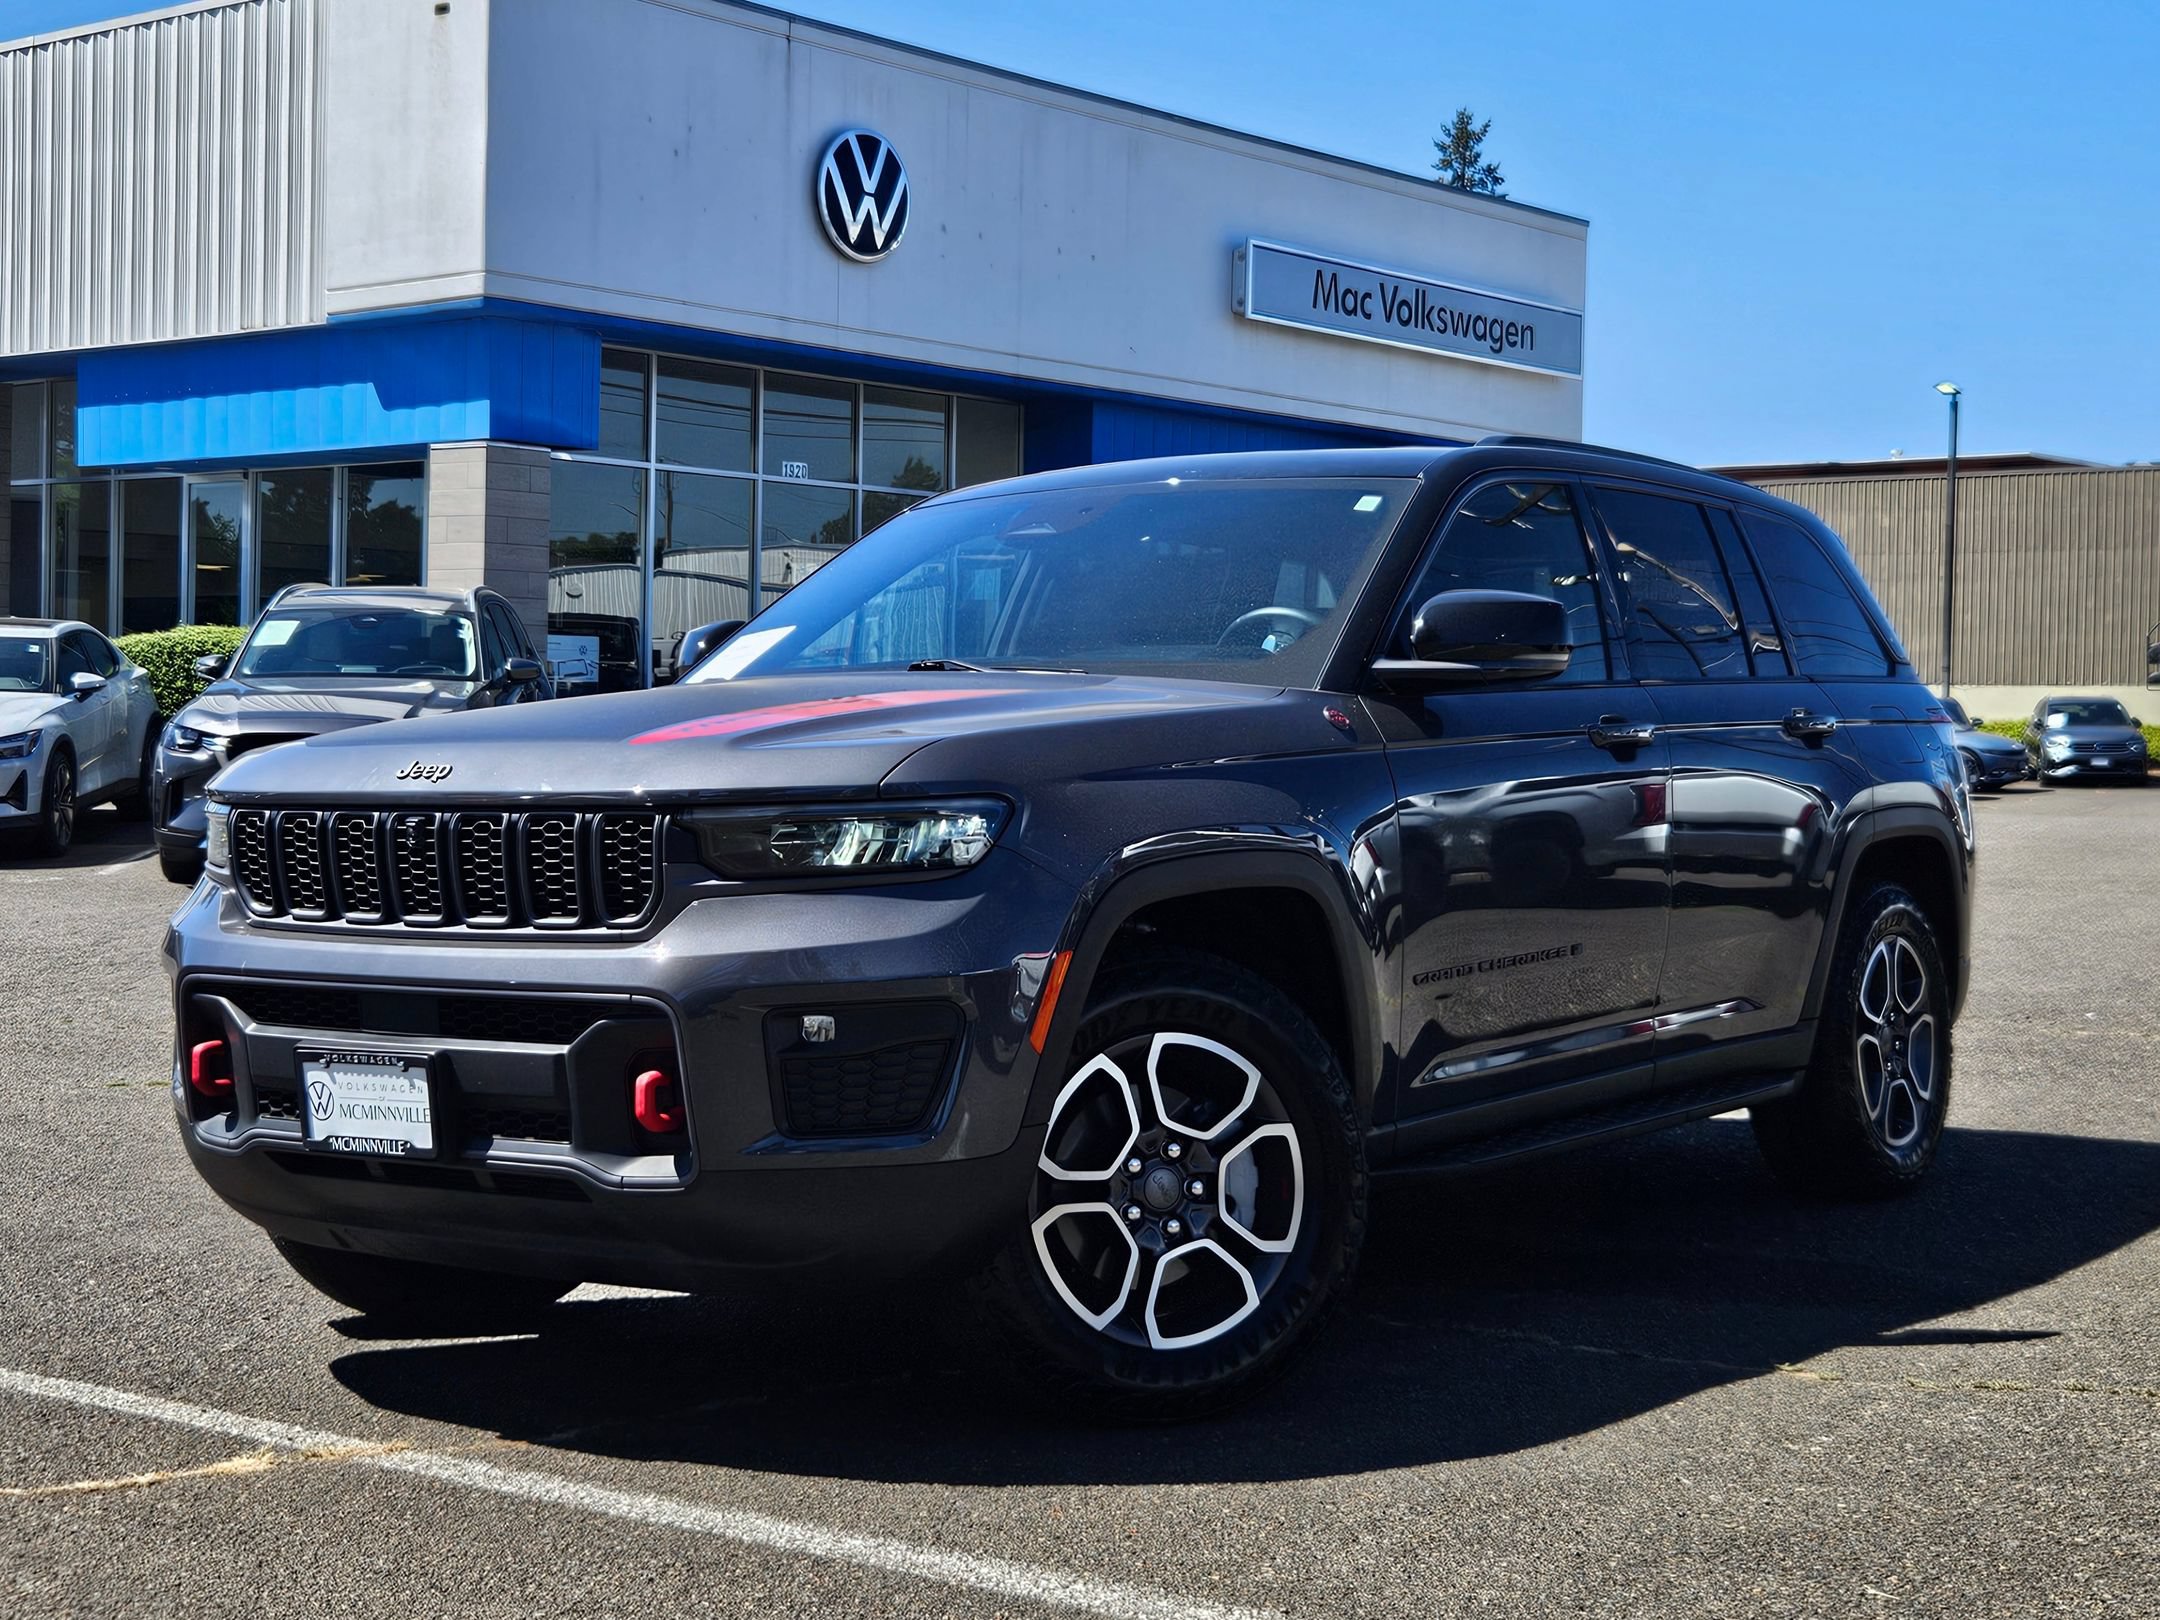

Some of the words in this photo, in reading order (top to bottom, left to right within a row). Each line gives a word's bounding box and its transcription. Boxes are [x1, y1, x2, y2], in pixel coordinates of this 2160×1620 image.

[1312, 269, 1372, 320] Mac
[1379, 282, 1535, 354] Volkswagen
[784, 463, 807, 479] 1920
[396, 760, 453, 783] Jeep
[323, 1054, 399, 1065] VOLKSWAGEN
[338, 1081, 424, 1094] VOLKSWAGEN
[339, 1103, 431, 1124] MCMINNVILLE
